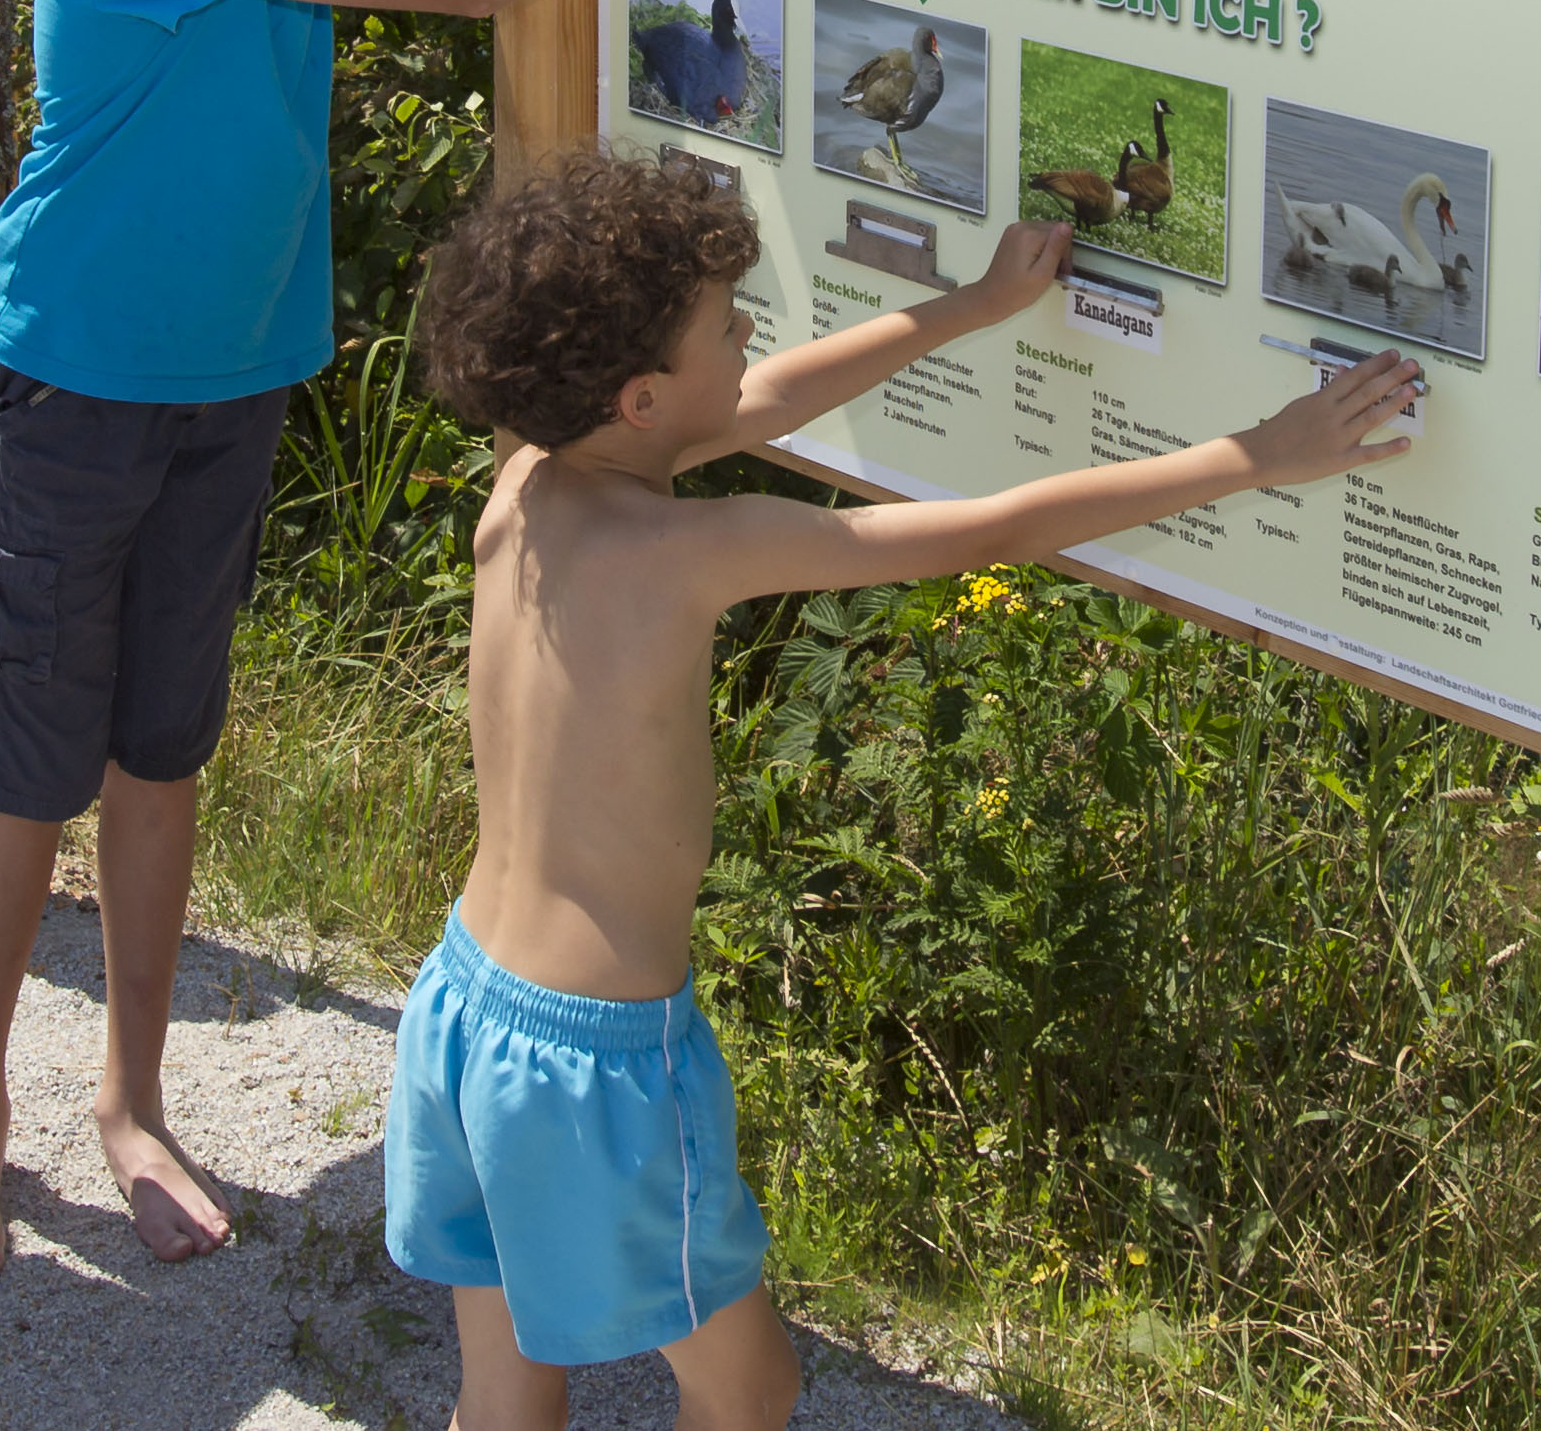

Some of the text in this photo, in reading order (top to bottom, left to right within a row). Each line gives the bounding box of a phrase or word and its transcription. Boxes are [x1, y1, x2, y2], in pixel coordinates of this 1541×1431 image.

[813, 274, 882, 308] Steckbrief
[1074, 294, 1153, 338] Kanadagans
[1016, 341, 1094, 377] Steckbrief
[909, 364, 982, 398] Beeren, Insekten,
[884, 390, 924, 412] Muscheln
[884, 407, 946, 437] 2 Jahresbruten
[1091, 426, 1116, 444] Gras,
[1092, 408, 1102, 420] 26
[1105, 412, 1130, 431] Tage,
[1179, 511, 1227, 538] Zugvogel,
[1256, 519, 1300, 544] Typisch:
[1345, 493, 1459, 540] 36 Tage, Nestflüchter
[1179, 529, 1213, 550] 182 cm
[1344, 511, 1500, 575] Wasserpflanzen, Gras, Raps,
[1344, 531, 1502, 594] Getreidepflanzen, Schnecken
[1342, 568, 1490, 631] binden sich auf Lebenszeit,
[1343, 550, 1502, 616] größter heimischer Zugvogel,
[1342, 588, 1482, 647] Flügelspannweite: 245 cm
[1255, 607, 1308, 635] Konzeption
[1310, 628, 1328, 641] und
[1330, 635, 1386, 665] estaltung:
